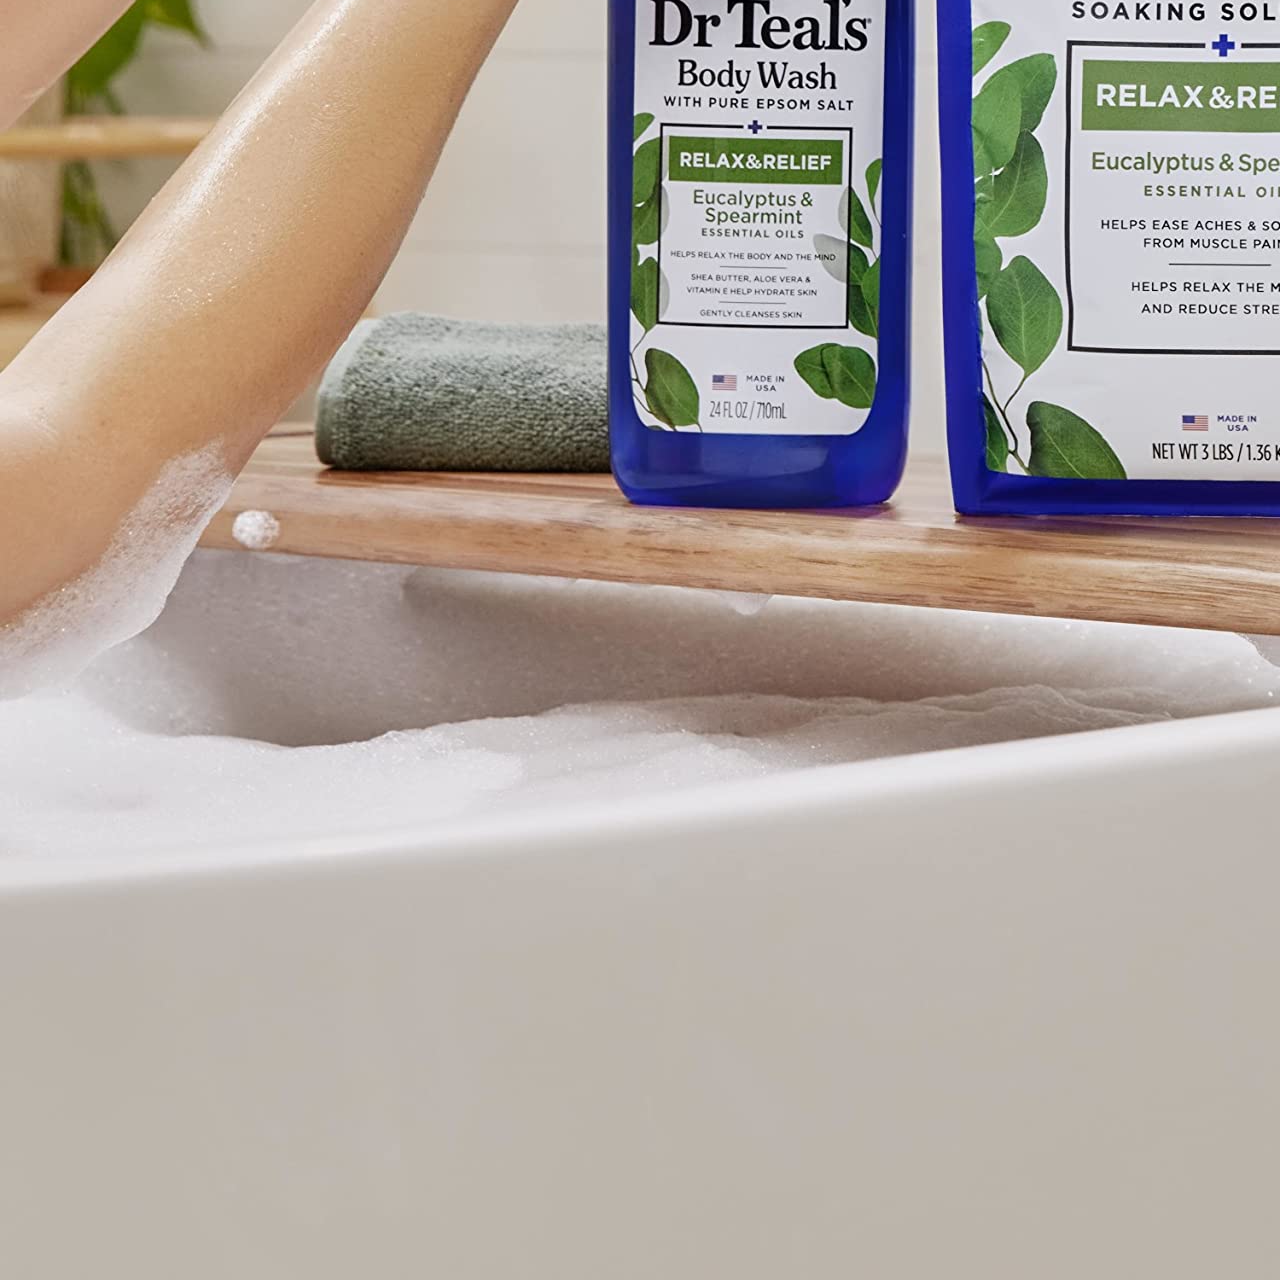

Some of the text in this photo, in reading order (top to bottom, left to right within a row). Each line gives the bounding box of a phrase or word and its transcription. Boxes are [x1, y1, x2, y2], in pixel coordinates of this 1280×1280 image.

[1071, 0, 1206, 21] SOAKING
[678, 59, 837, 94] Body Wash
[664, 96, 854, 111] WITH PURE EPSOM SALT
[1091, 151, 1215, 175] Eucalyptus
[1219, 152, 1235, 172] &
[1144, 185, 1246, 199] ESSENTIAL
[693, 189, 813, 209] Eucalyptus &
[705, 207, 802, 225] Spearmint
[1100, 220, 1148, 231] HELPS
[1152, 220, 1191, 231] EASE
[1194, 220, 1243, 231] ACHES
[1247, 220, 1257, 231] &
[701, 228, 804, 239] ESSENTIAL OILS
[1143, 238, 1185, 250] FROM
[1190, 238, 1248, 250] MUSCLE
[697, 251, 726, 259] RELAX
[747, 252, 771, 261] BODY
[774, 253, 793, 261] AND
[796, 253, 812, 261] THE
[814, 253, 836, 261] MIND
[691, 274, 713, 282] SHEA
[715, 274, 751, 283] BUTTER,
[754, 275, 776, 283] ALOE
[686, 287, 721, 295] VITAMIN
[722, 287, 727, 295] E
[730, 287, 752, 295] HELP
[754, 288, 795, 296] HYDRATE
[1131, 281, 1178, 293] HELPS
[1183, 282, 1231, 293] RELAX
[1237, 282, 1266, 293] THE
[735, 310, 780, 318] CLEANSES
[1141, 304, 1174, 315] AND
[1178, 304, 1239, 315] REDUCE
[746, 375, 772, 383] MADE
[756, 384, 777, 392] USA
[710, 401, 721, 418] 24
[723, 401, 733, 418] FL
[735, 401, 748, 418] OZ
[756, 401, 787, 419] 710mL
[1217, 415, 1257, 423] MADE IN
[1152, 443, 1176, 460] NET
[1179, 443, 1198, 460] WT
[1200, 443, 1209, 460] 3
[1212, 443, 1234, 460] LBS
[1245, 443, 1272, 461] 1.36
